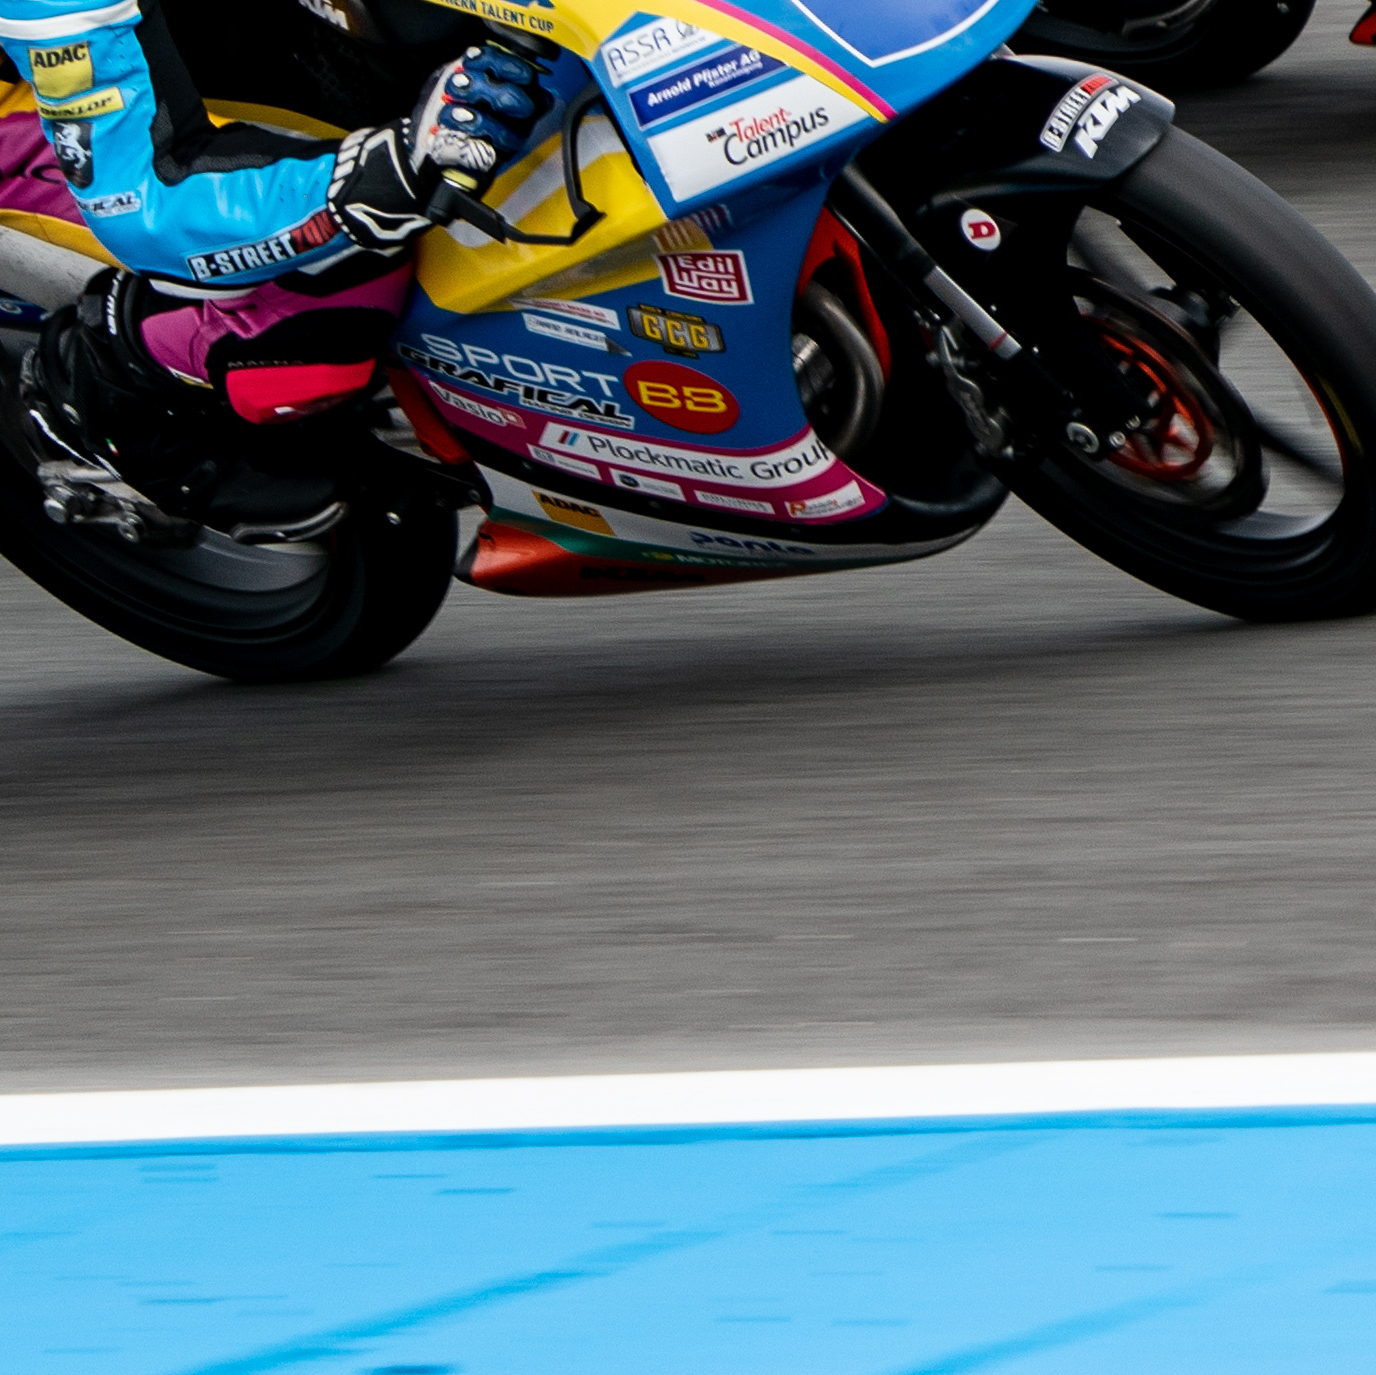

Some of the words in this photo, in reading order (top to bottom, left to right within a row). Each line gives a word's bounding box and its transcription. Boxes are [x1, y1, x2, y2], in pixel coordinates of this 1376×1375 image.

[528, 13, 555, 34] CUP
[33, 43, 88, 68] ADAC
[646, 77, 693, 107] Arnold
[693, 58, 739, 87] Pfister
[739, 49, 762, 66] AG
[724, 106, 829, 166] Campus
[729, 107, 788, 144] Talent
[1074, 85, 1142, 159] KTM
[676, 255, 735, 274] Edil
[398, 343, 633, 424] GRAFICAL
[421, 332, 620, 398] SPORT
[587, 434, 744, 481] Plockmatic
[539, 494, 603, 519] ADAC
